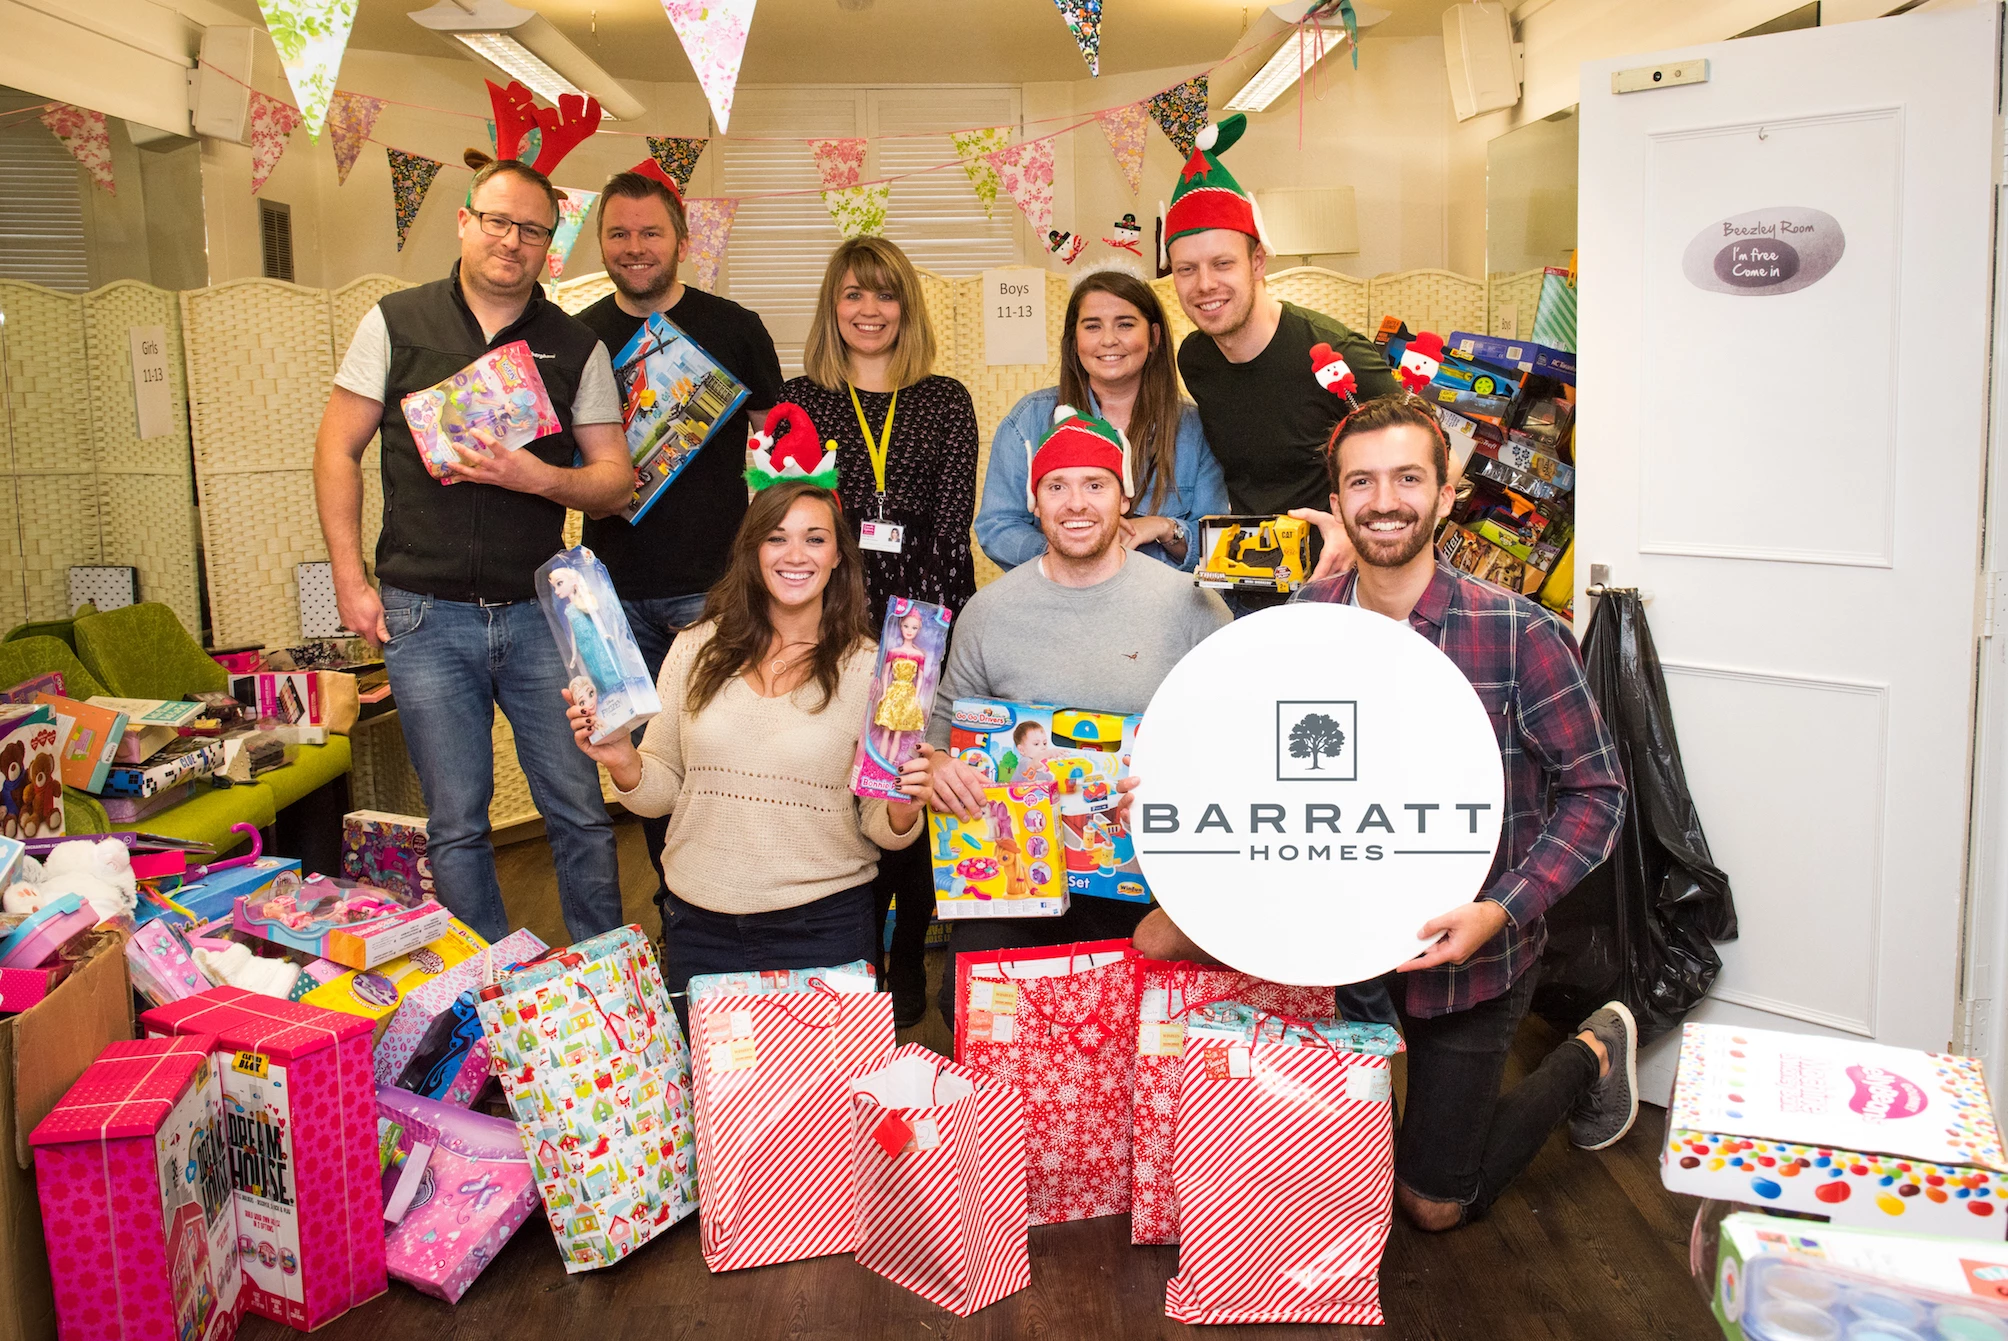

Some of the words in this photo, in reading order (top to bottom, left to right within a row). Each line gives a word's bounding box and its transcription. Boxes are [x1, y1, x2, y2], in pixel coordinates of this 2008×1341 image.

[1723, 220, 1776, 239] Beezley
[1780, 220, 1815, 234] Room
[1732, 246, 1748, 262] I'm
[1750, 247, 1779, 262] free
[1732, 263, 1768, 277] Come
[1769, 265, 1780, 277] in
[999, 282, 1030, 298] Boys
[997, 305, 1033, 319] 11-13
[1501, 318, 1512, 332] Boys
[142, 340, 158, 355] Girls
[143, 367, 163, 383] 11-13
[1281, 531, 1293, 539] CAT
[956, 711, 967, 720] Go
[967, 712, 978, 721] Go
[978, 713, 1005, 725] Drivers
[862, 778, 889, 790] Bonnie
[1142, 803, 1492, 834] BARRATT
[1249, 845, 1385, 861] HOMES
[1068, 874, 1091, 889] Set
[228, 1112, 282, 1160] DREAM
